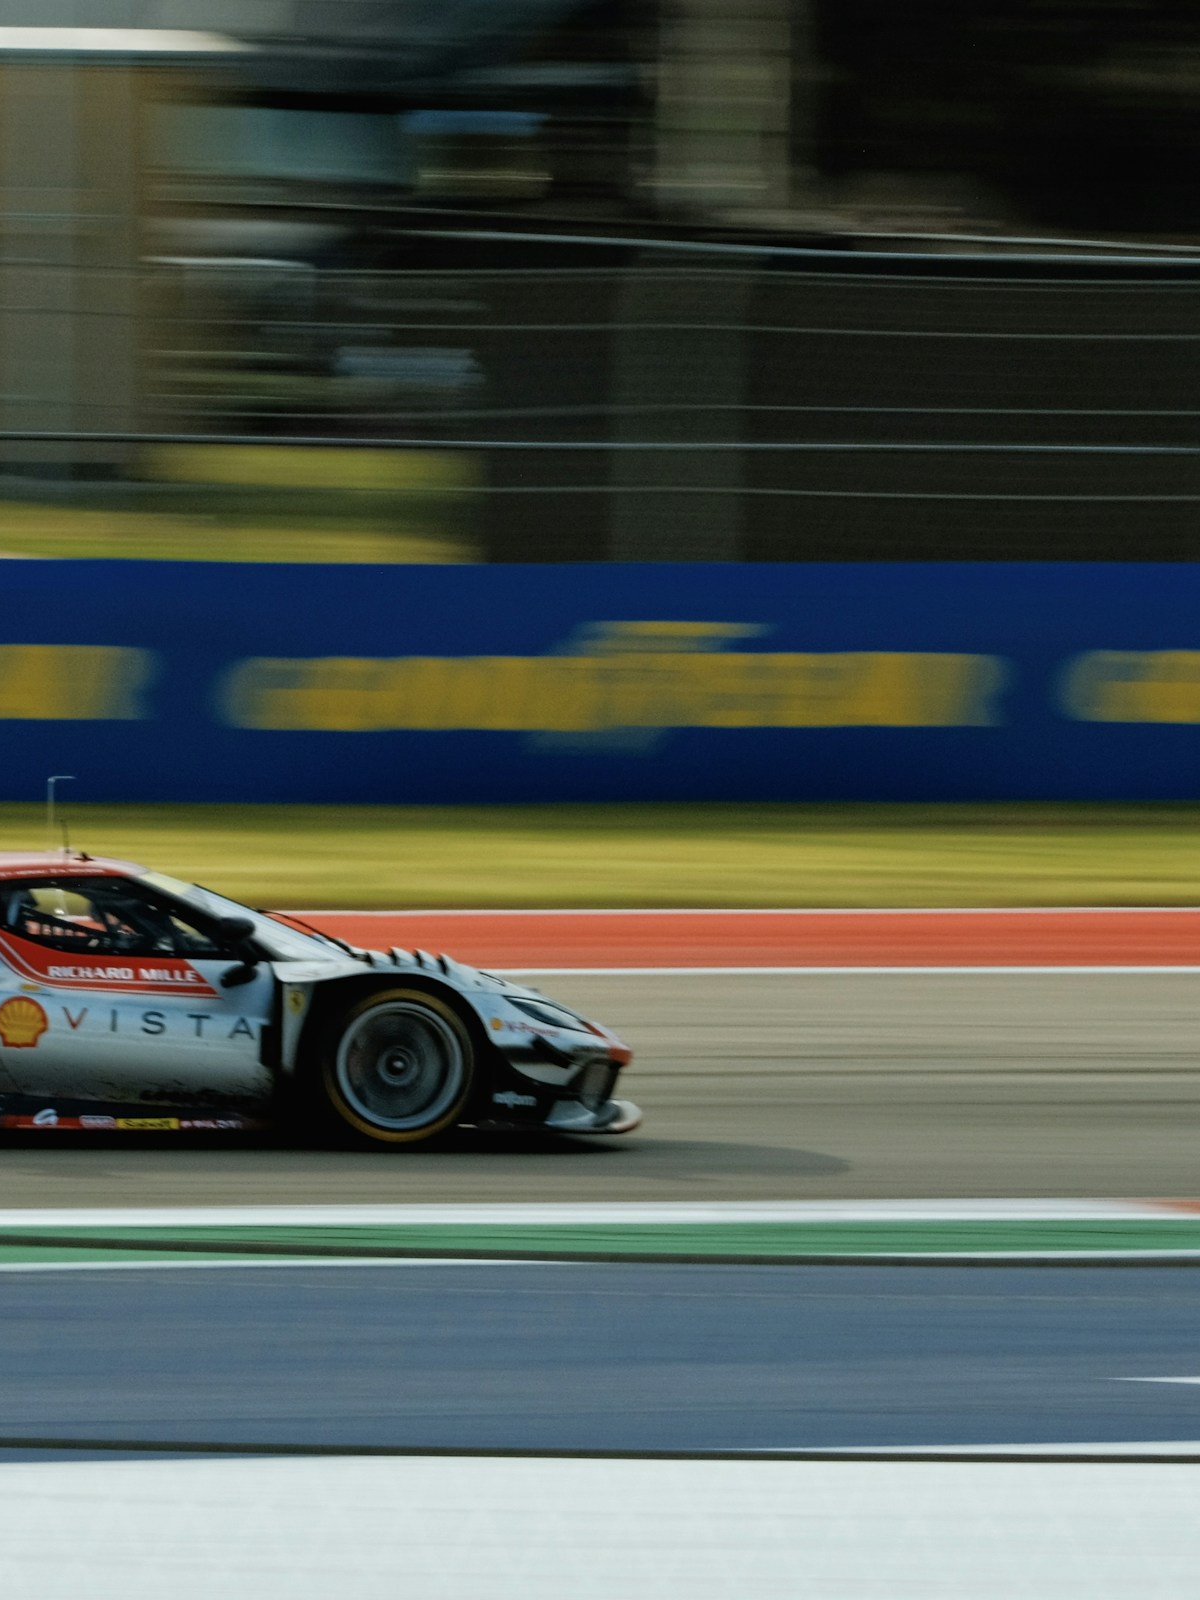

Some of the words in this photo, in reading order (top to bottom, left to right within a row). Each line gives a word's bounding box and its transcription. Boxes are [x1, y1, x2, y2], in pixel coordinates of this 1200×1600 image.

[47, 966, 133, 980] RICHARD
[138, 968, 198, 982] MILLE
[62, 1006, 255, 1040] VISTA
